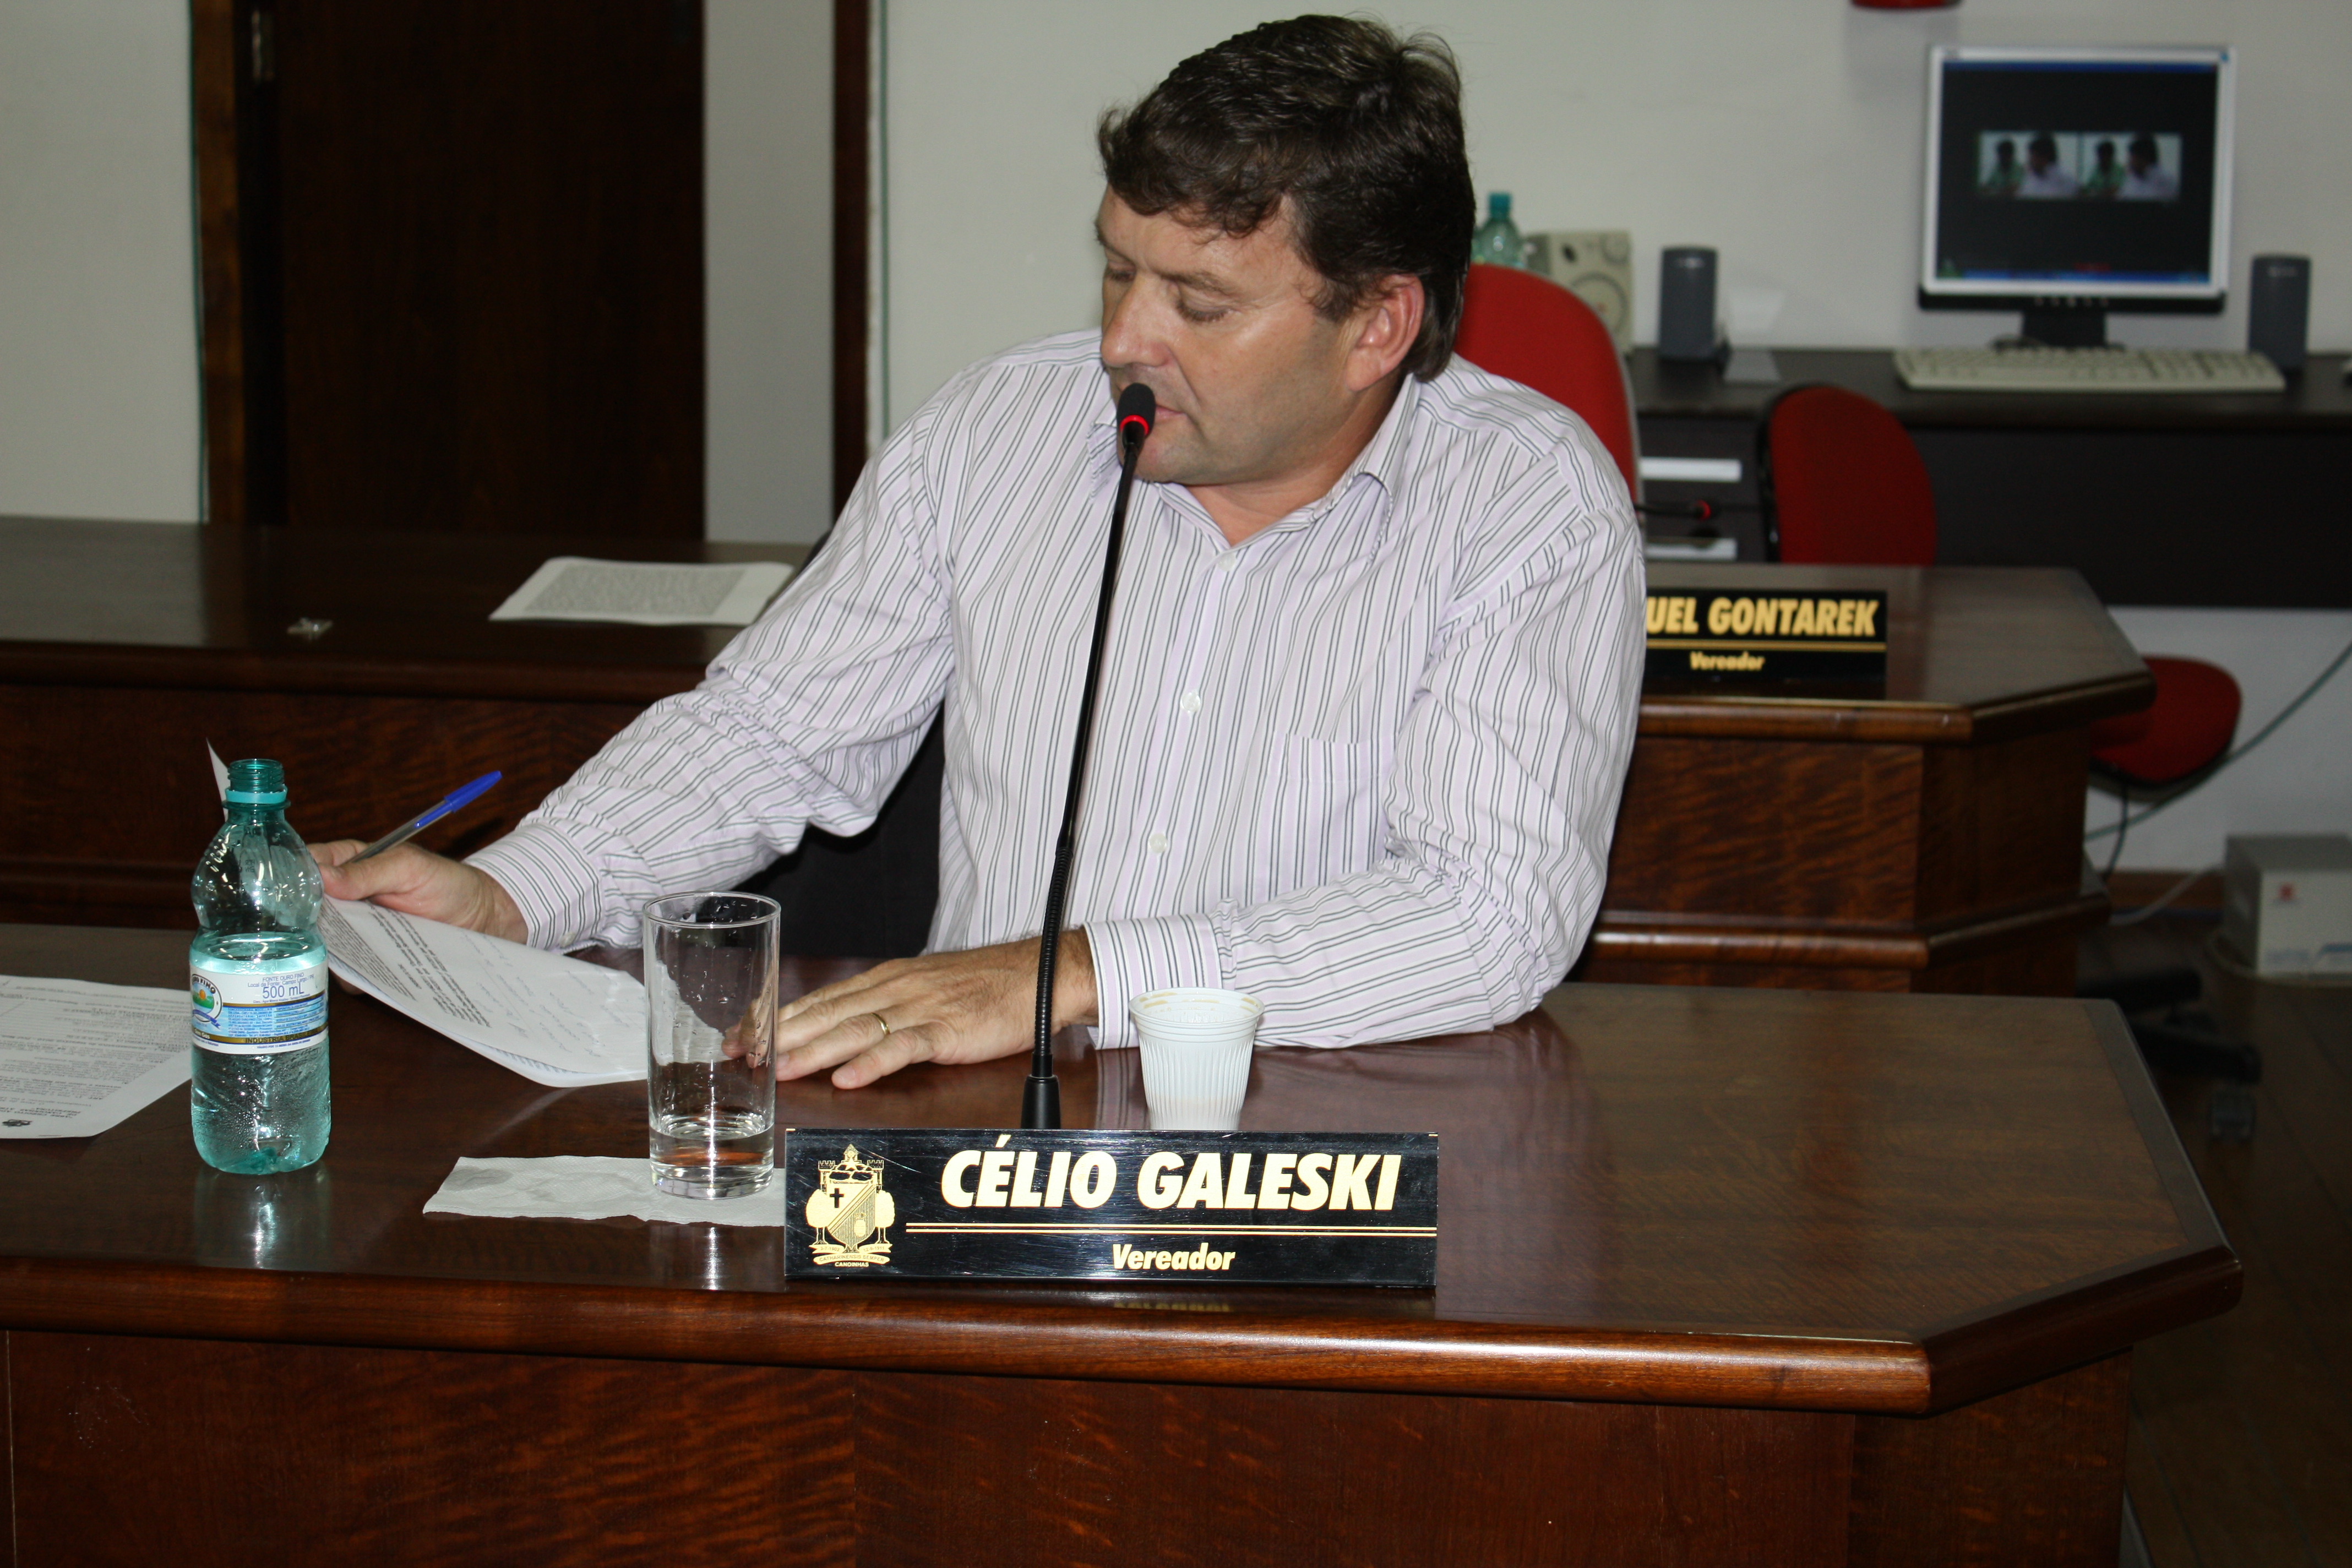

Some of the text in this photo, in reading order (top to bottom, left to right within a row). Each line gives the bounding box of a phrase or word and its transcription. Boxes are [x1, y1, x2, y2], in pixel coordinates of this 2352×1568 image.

[1708, 598, 1879, 635] GONTAREK
[1690, 651, 1764, 671] Vereador
[262, 985, 285, 999] 500
[289, 982, 304, 996] mL
[941, 1134, 1402, 1211] CÉLIO GALESKI
[1112, 1242, 1235, 1271] Vereador
